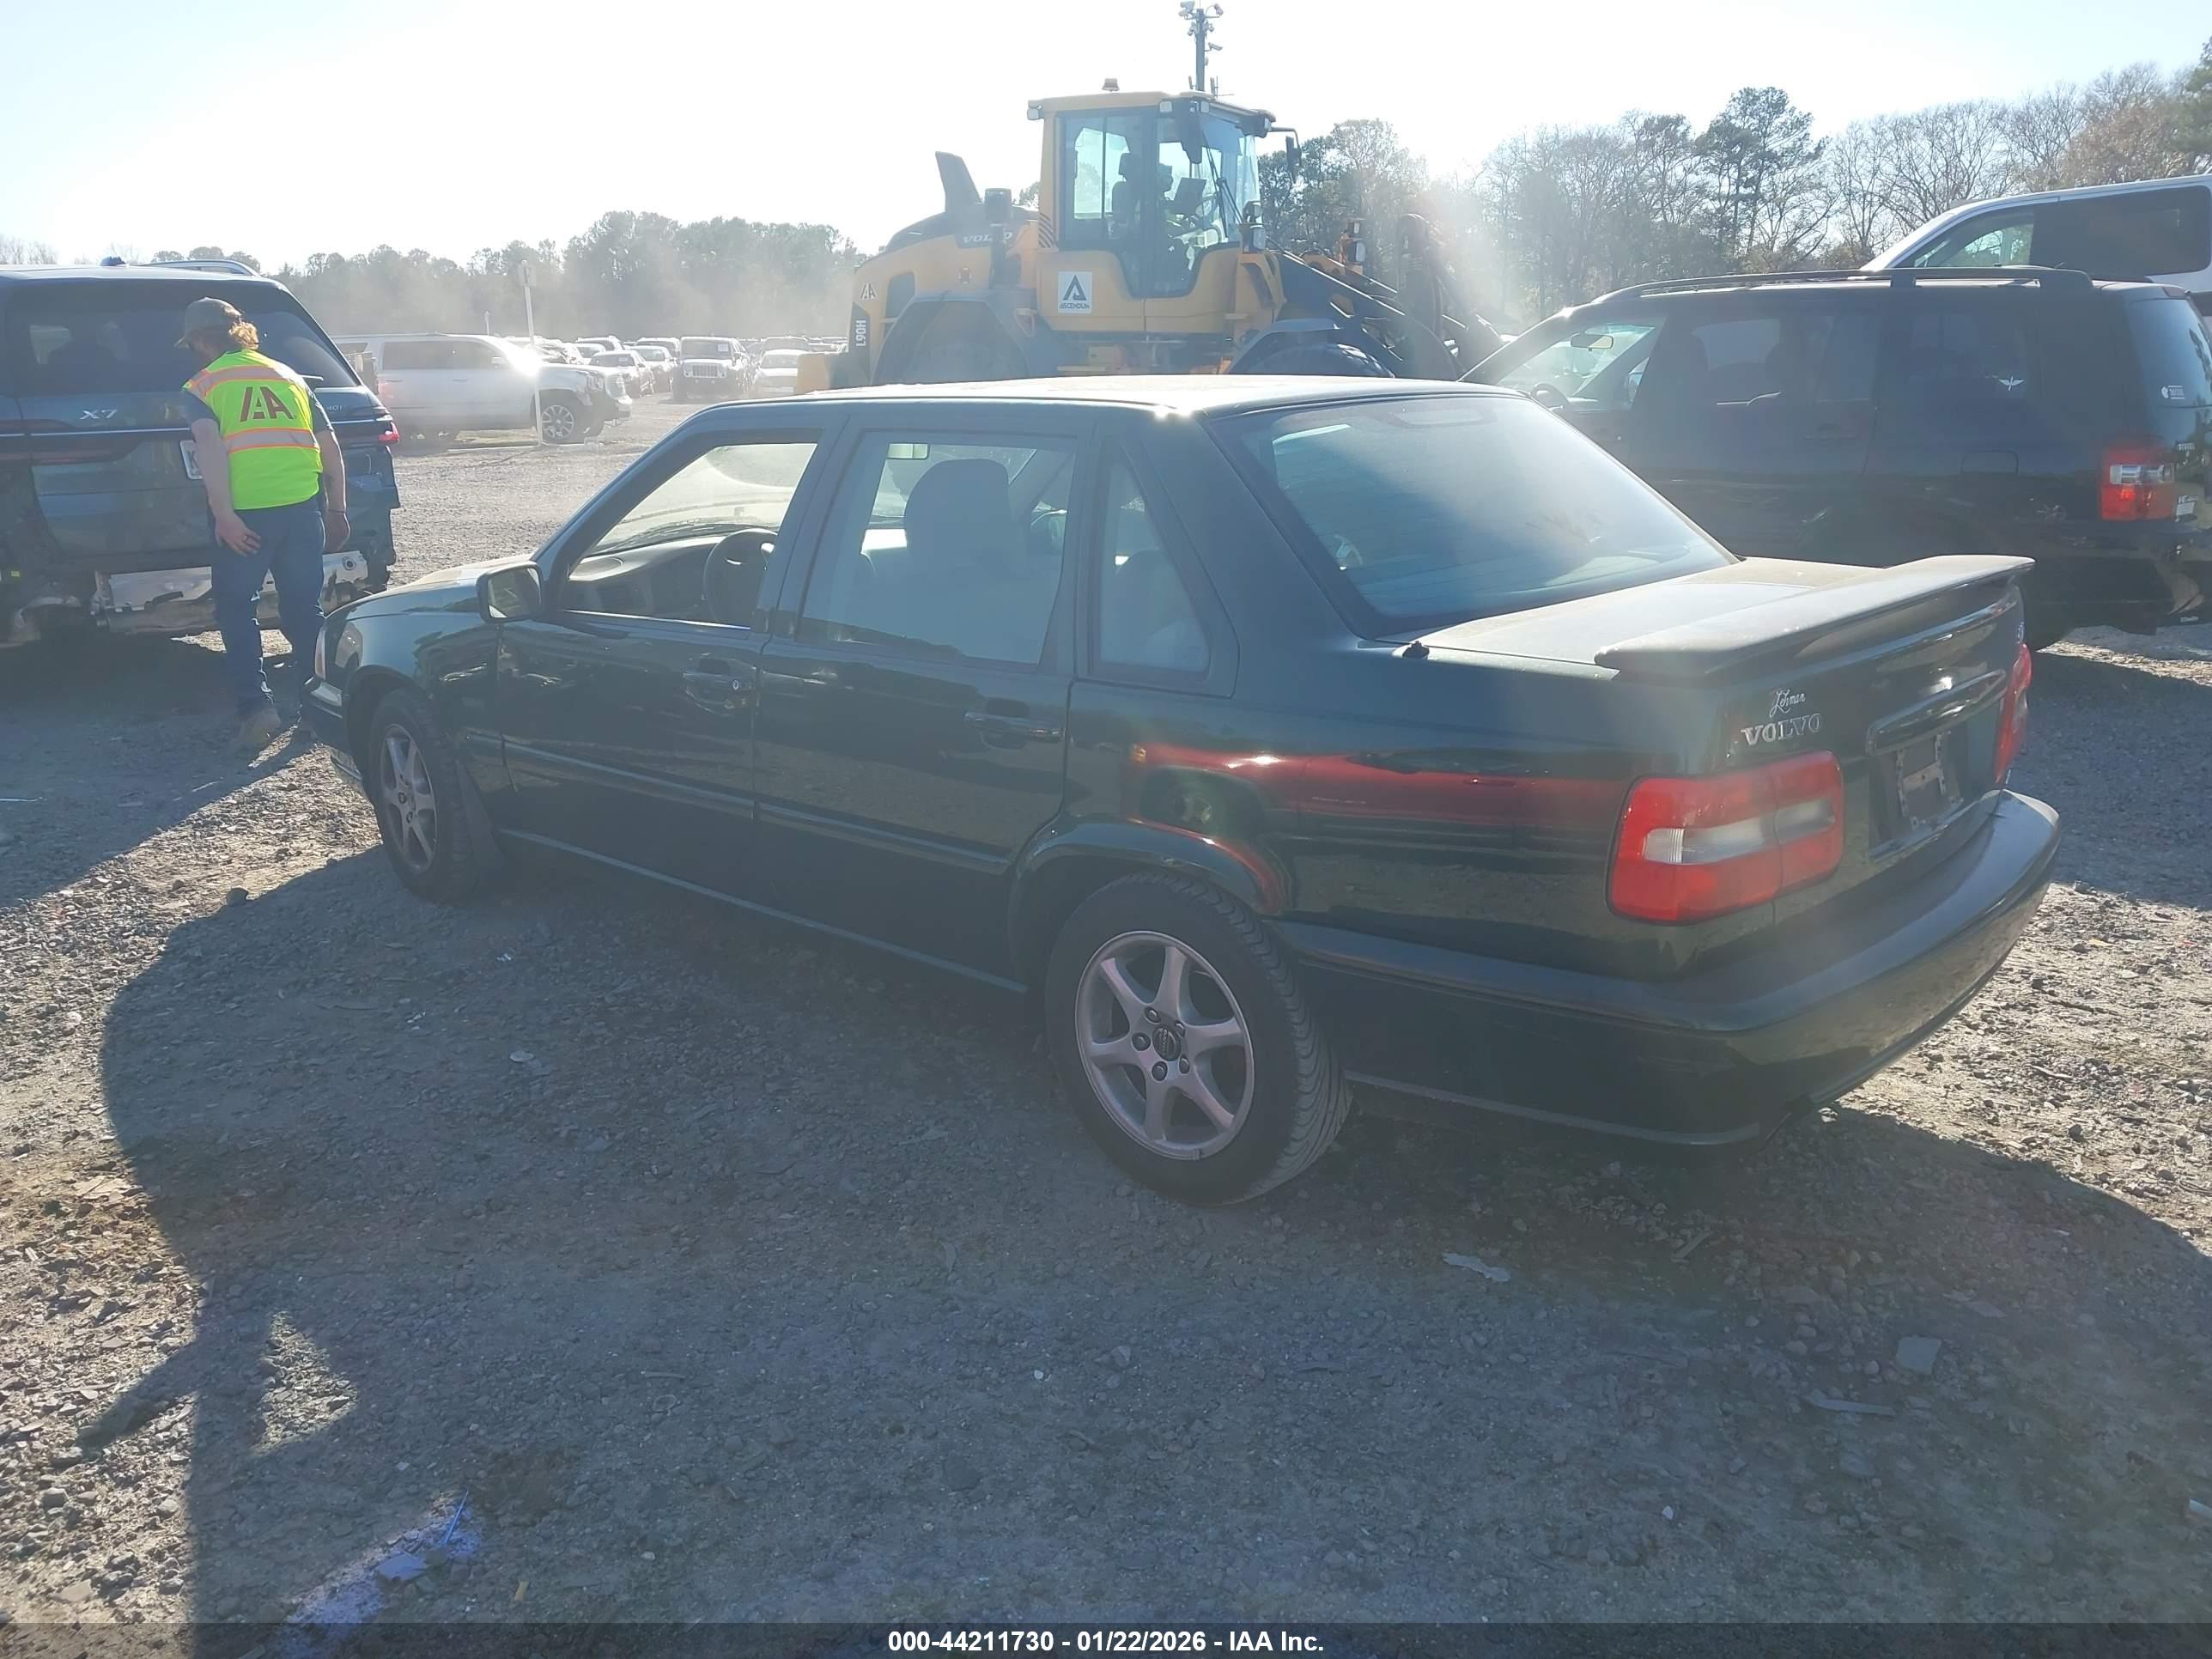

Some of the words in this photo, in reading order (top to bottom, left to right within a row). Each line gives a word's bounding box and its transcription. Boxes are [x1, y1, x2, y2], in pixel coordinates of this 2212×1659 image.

[963, 231, 1013, 243] VOLO
[855, 319, 866, 347] L90H
[80, 409, 118, 420] X7
[1741, 713, 1820, 745] VOLVO
